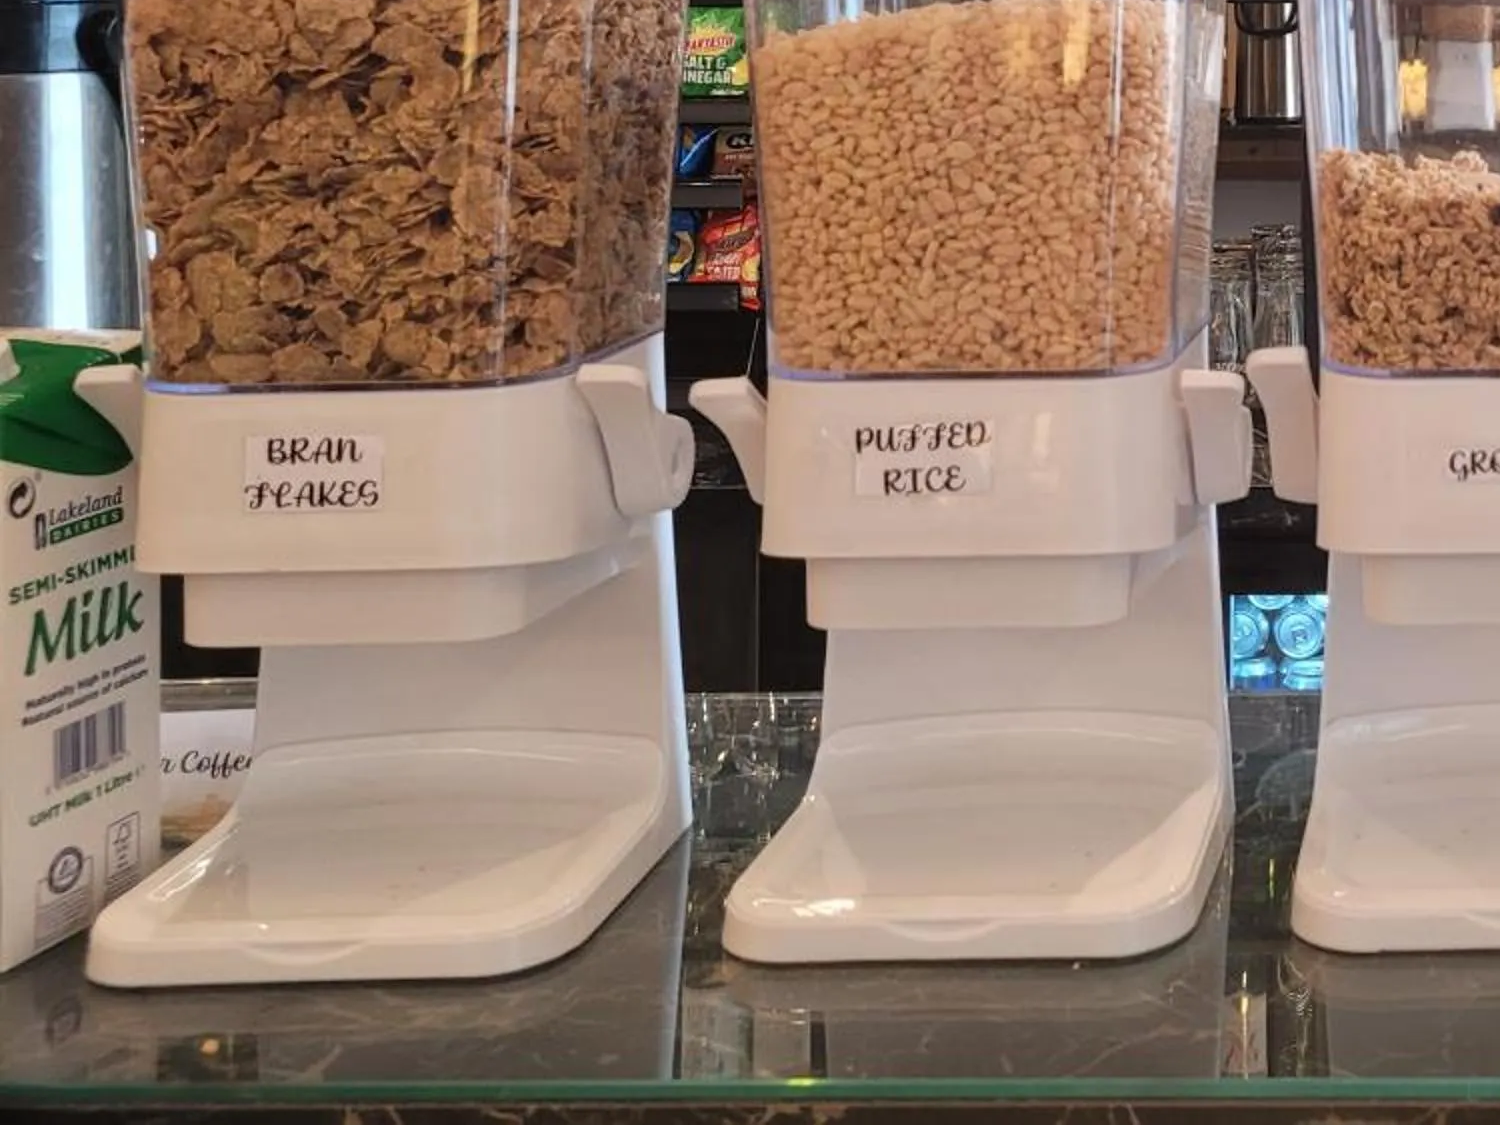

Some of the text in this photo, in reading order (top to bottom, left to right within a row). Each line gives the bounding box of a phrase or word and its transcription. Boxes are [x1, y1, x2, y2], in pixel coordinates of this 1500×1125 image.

[682, 71, 733, 85] INEGAR
[267, 437, 363, 465] BRAN
[855, 421, 992, 454] PUFFED
[244, 480, 378, 509] FLAKES
[883, 465, 966, 497] RICE
[49, 486, 124, 526] Lakeland
[9, 546, 136, 605] SEMI-SKIMM
[24, 581, 144, 677] Milk
